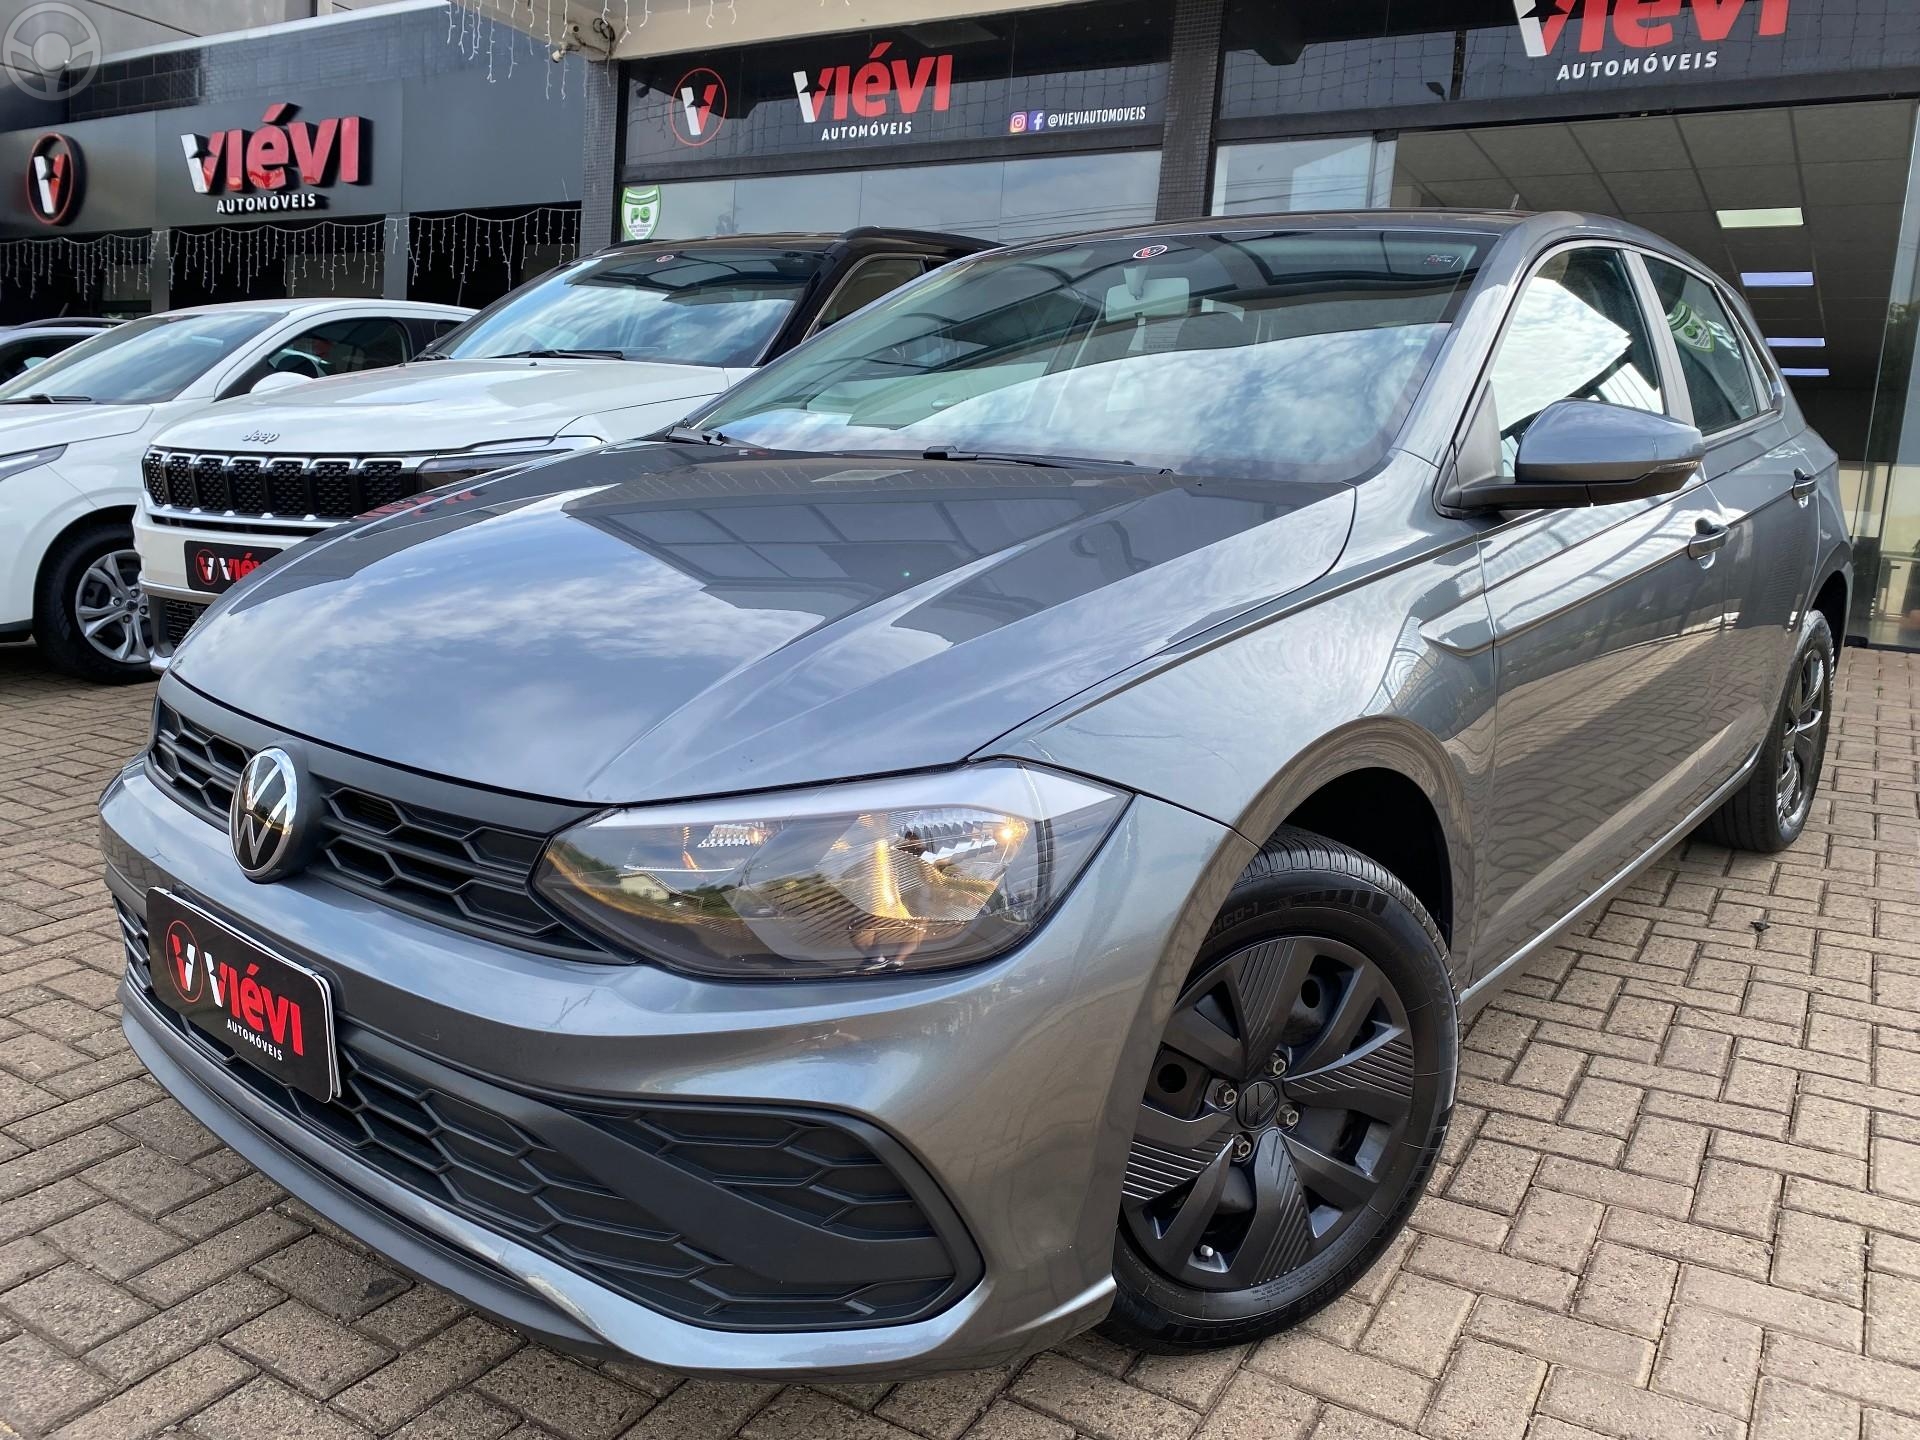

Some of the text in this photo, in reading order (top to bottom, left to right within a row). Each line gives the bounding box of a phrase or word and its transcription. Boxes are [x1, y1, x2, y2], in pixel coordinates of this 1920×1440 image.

[1556, 51, 1719, 81] AUTOMÓVEIS
[1047, 106, 1147, 128] @VIEVIAUTOMOVEIS
[821, 121, 912, 141] AUTOMÓVEIS
[216, 191, 317, 214] AUTOMÓVEIS
[241, 429, 280, 444] Jeep
[226, 1018, 283, 1062] AUTOMÓVEIS
